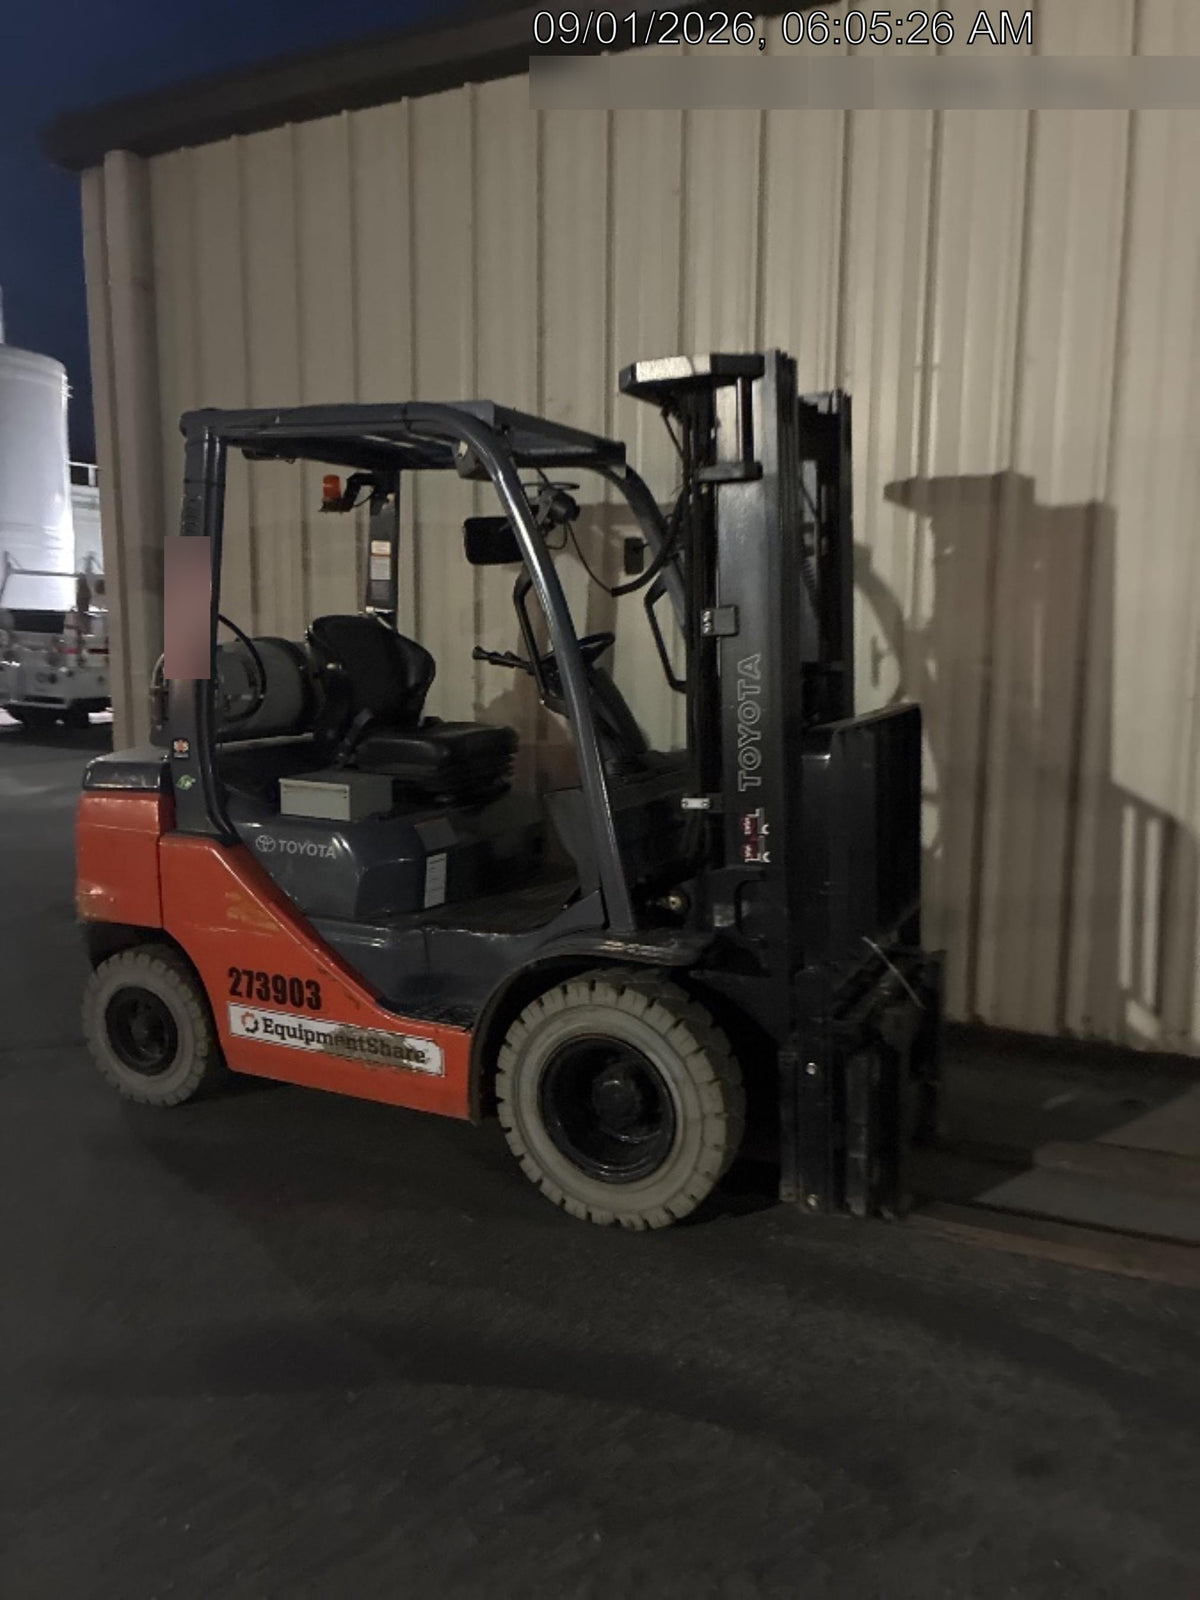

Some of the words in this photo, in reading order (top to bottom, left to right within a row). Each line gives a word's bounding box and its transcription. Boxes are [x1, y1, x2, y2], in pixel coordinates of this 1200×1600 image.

[738, 653, 762, 792] TOYOTA
[277, 839, 337, 859] TOYOTA
[228, 967, 322, 1010] 273903
[262, 1017, 426, 1063] EquipmentShare
